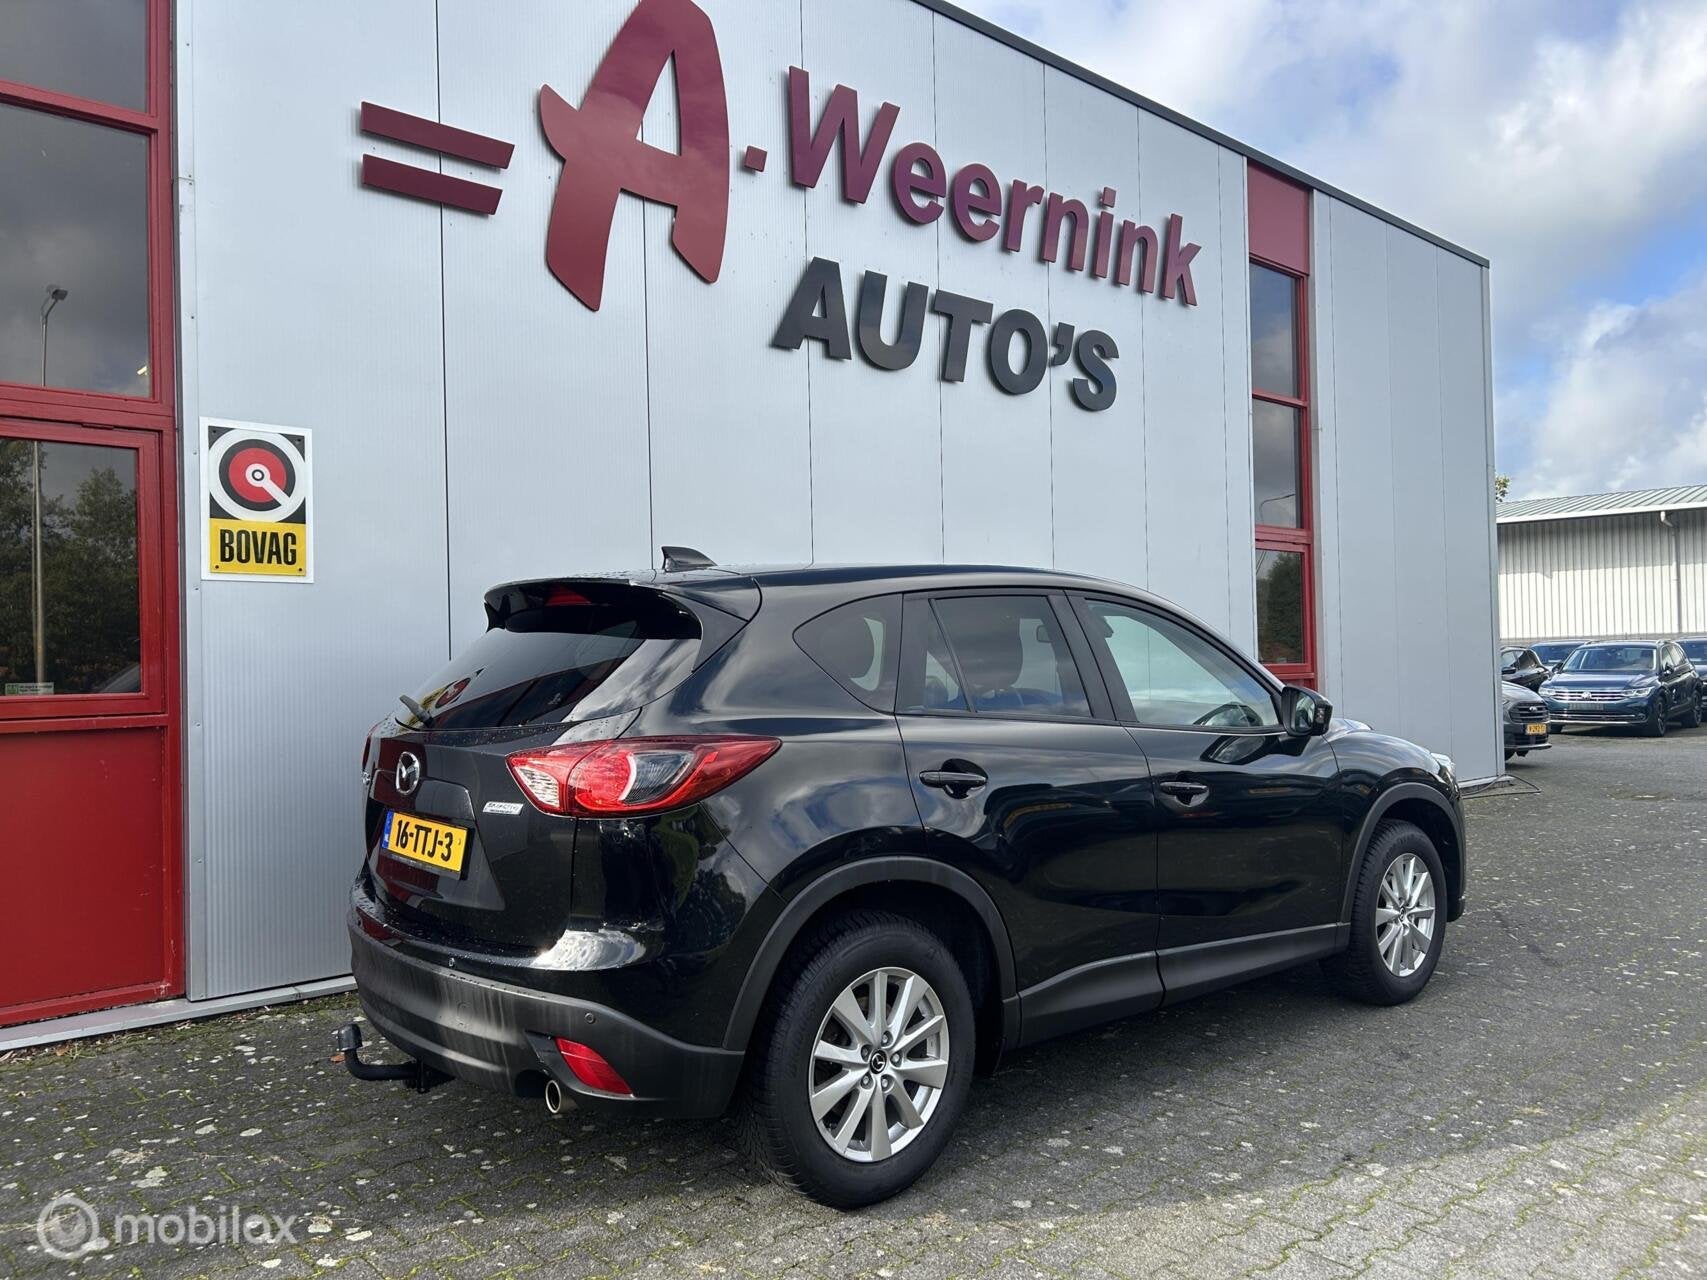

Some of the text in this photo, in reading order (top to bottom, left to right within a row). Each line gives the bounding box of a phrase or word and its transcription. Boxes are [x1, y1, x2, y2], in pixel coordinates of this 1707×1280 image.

[788, 65, 1202, 306] Weernink
[773, 256, 1120, 411] AUTO'S
[219, 528, 298, 566] BOVAG
[395, 819, 454, 862] 16-TTJ-3
